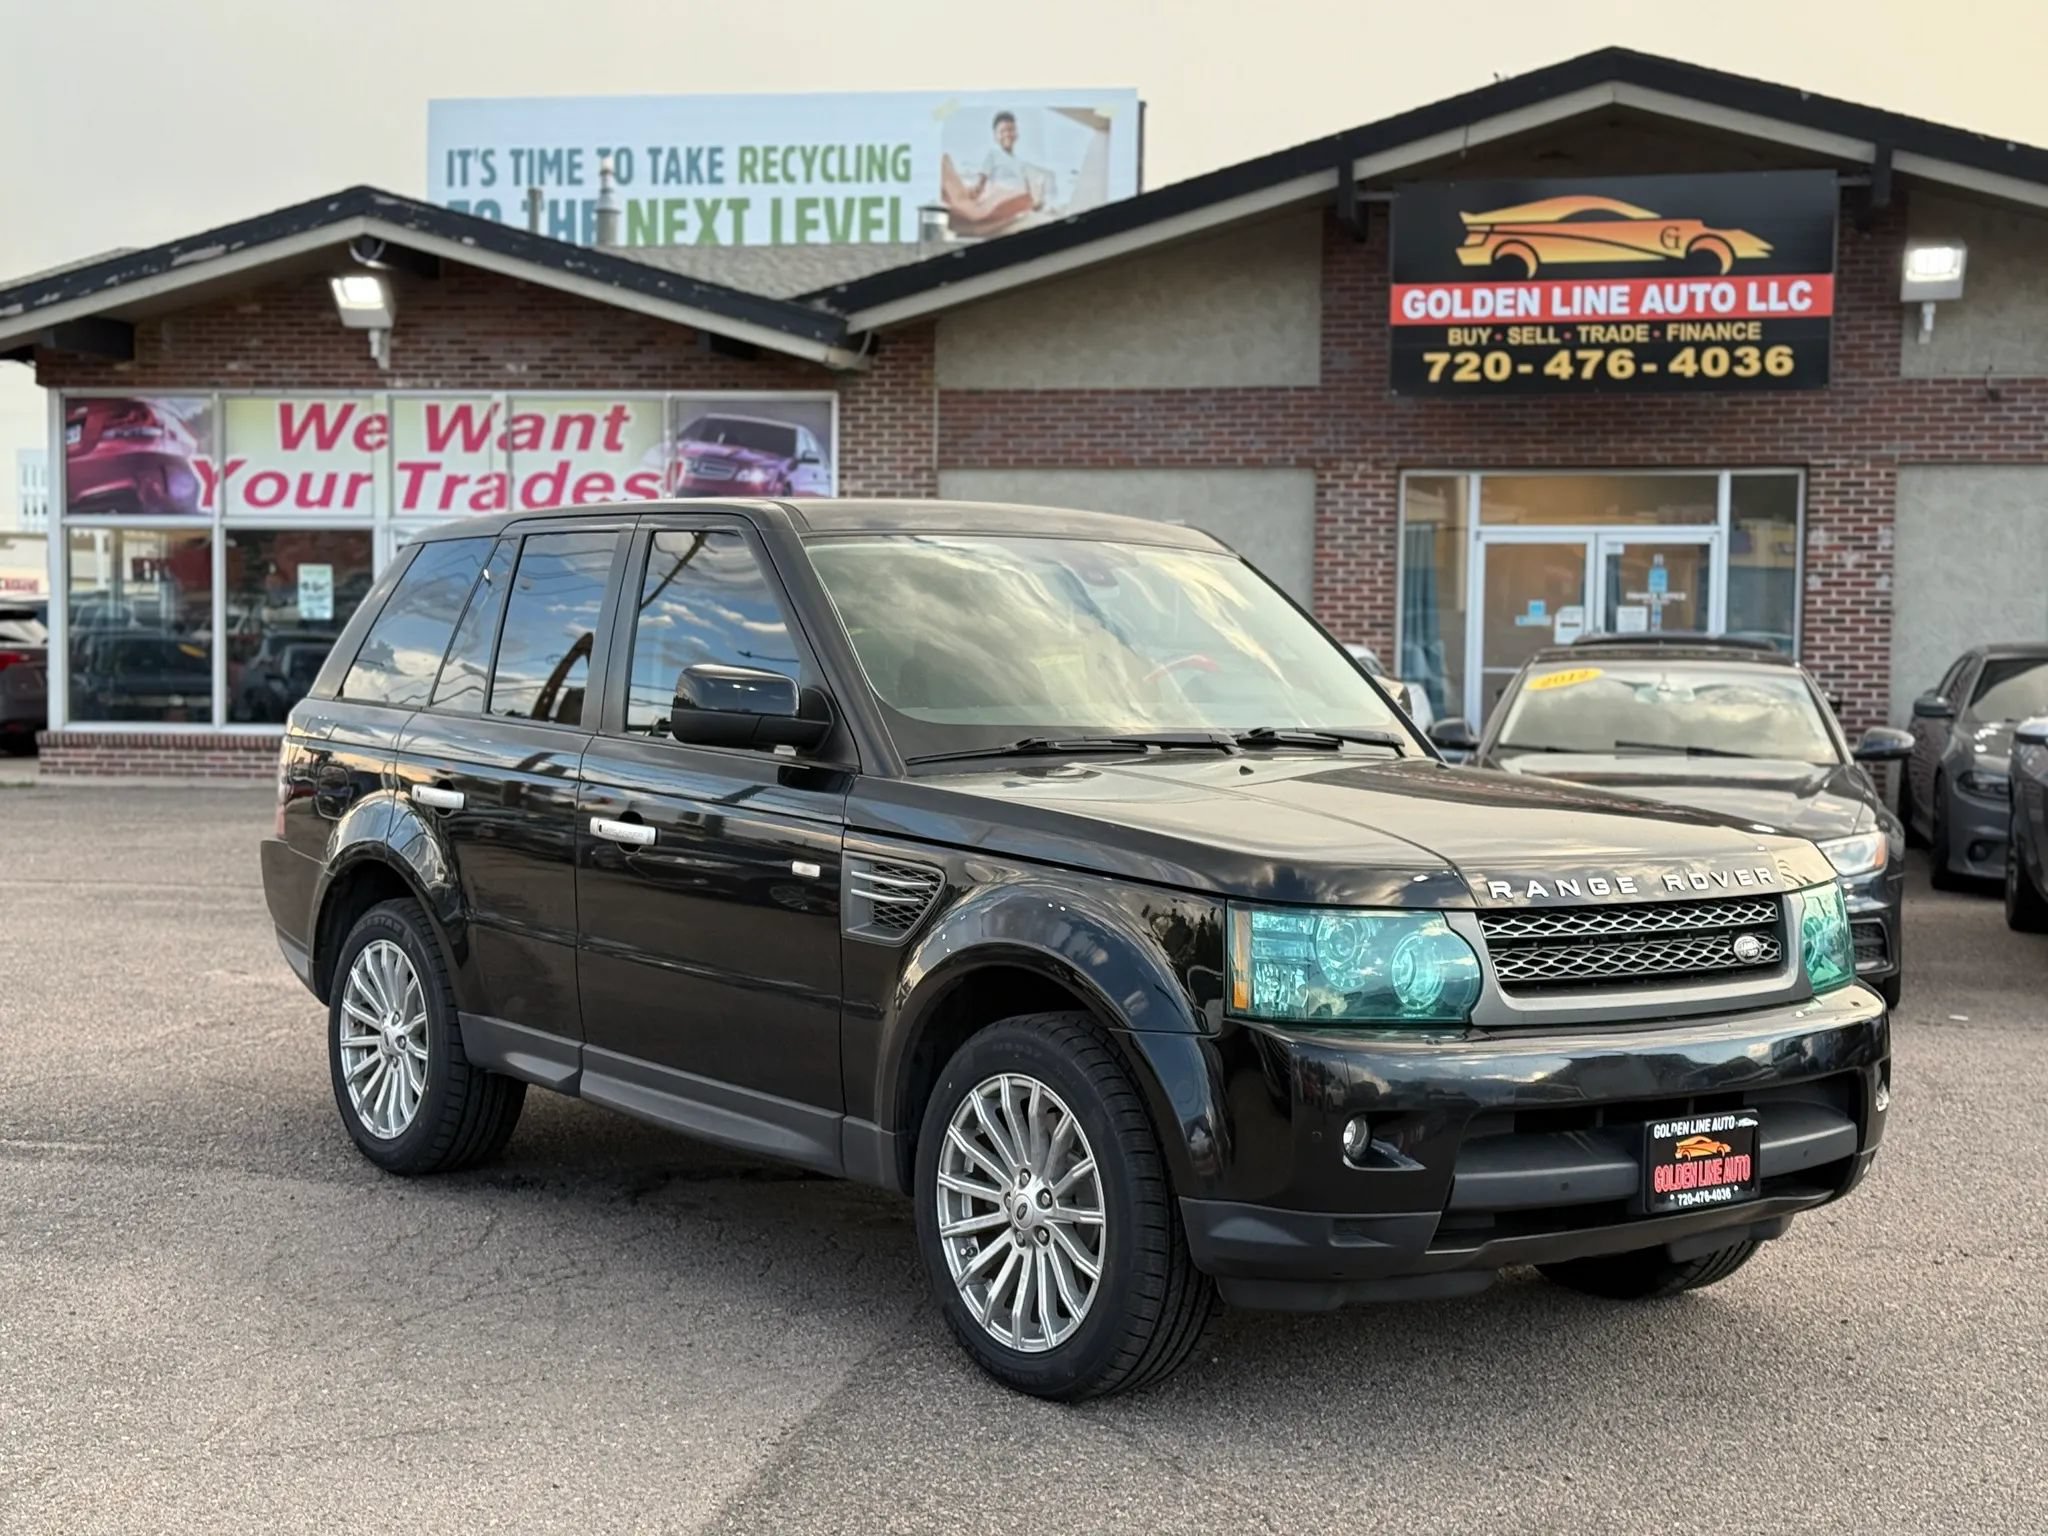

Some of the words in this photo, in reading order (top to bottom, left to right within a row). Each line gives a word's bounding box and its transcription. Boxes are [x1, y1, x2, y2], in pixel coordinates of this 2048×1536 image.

[447, 147, 497, 187] IT'S
[510, 148, 584, 186] TIME
[646, 147, 725, 185] TAKE
[738, 145, 911, 184] RECYCLING
[627, 198, 750, 246] NEXT
[1402, 287, 1541, 319] GOLDEN
[1551, 285, 1631, 316] LINE
[1640, 282, 1737, 314] AUTO
[1747, 280, 1813, 312] LLC
[1448, 327, 1493, 346] BUY
[1507, 326, 1561, 345] SELL
[1577, 323, 1650, 343] TRADE
[1666, 321, 1762, 341] FINANCE
[278, 403, 388, 452] We
[426, 404, 631, 452] Want
[192, 459, 373, 509] Your
[1487, 876, 1638, 900] RANGE
[1661, 866, 1775, 893] ROVER
[1654, 1121, 1689, 1139] GOLDEN
[1690, 1118, 1711, 1135] LINE
[1712, 1115, 1735, 1132] AUTO
[1654, 1161, 1698, 1193] GOLDEN
[1699, 1159, 1722, 1186] LINE
[1723, 1154, 1751, 1184] AUTO
